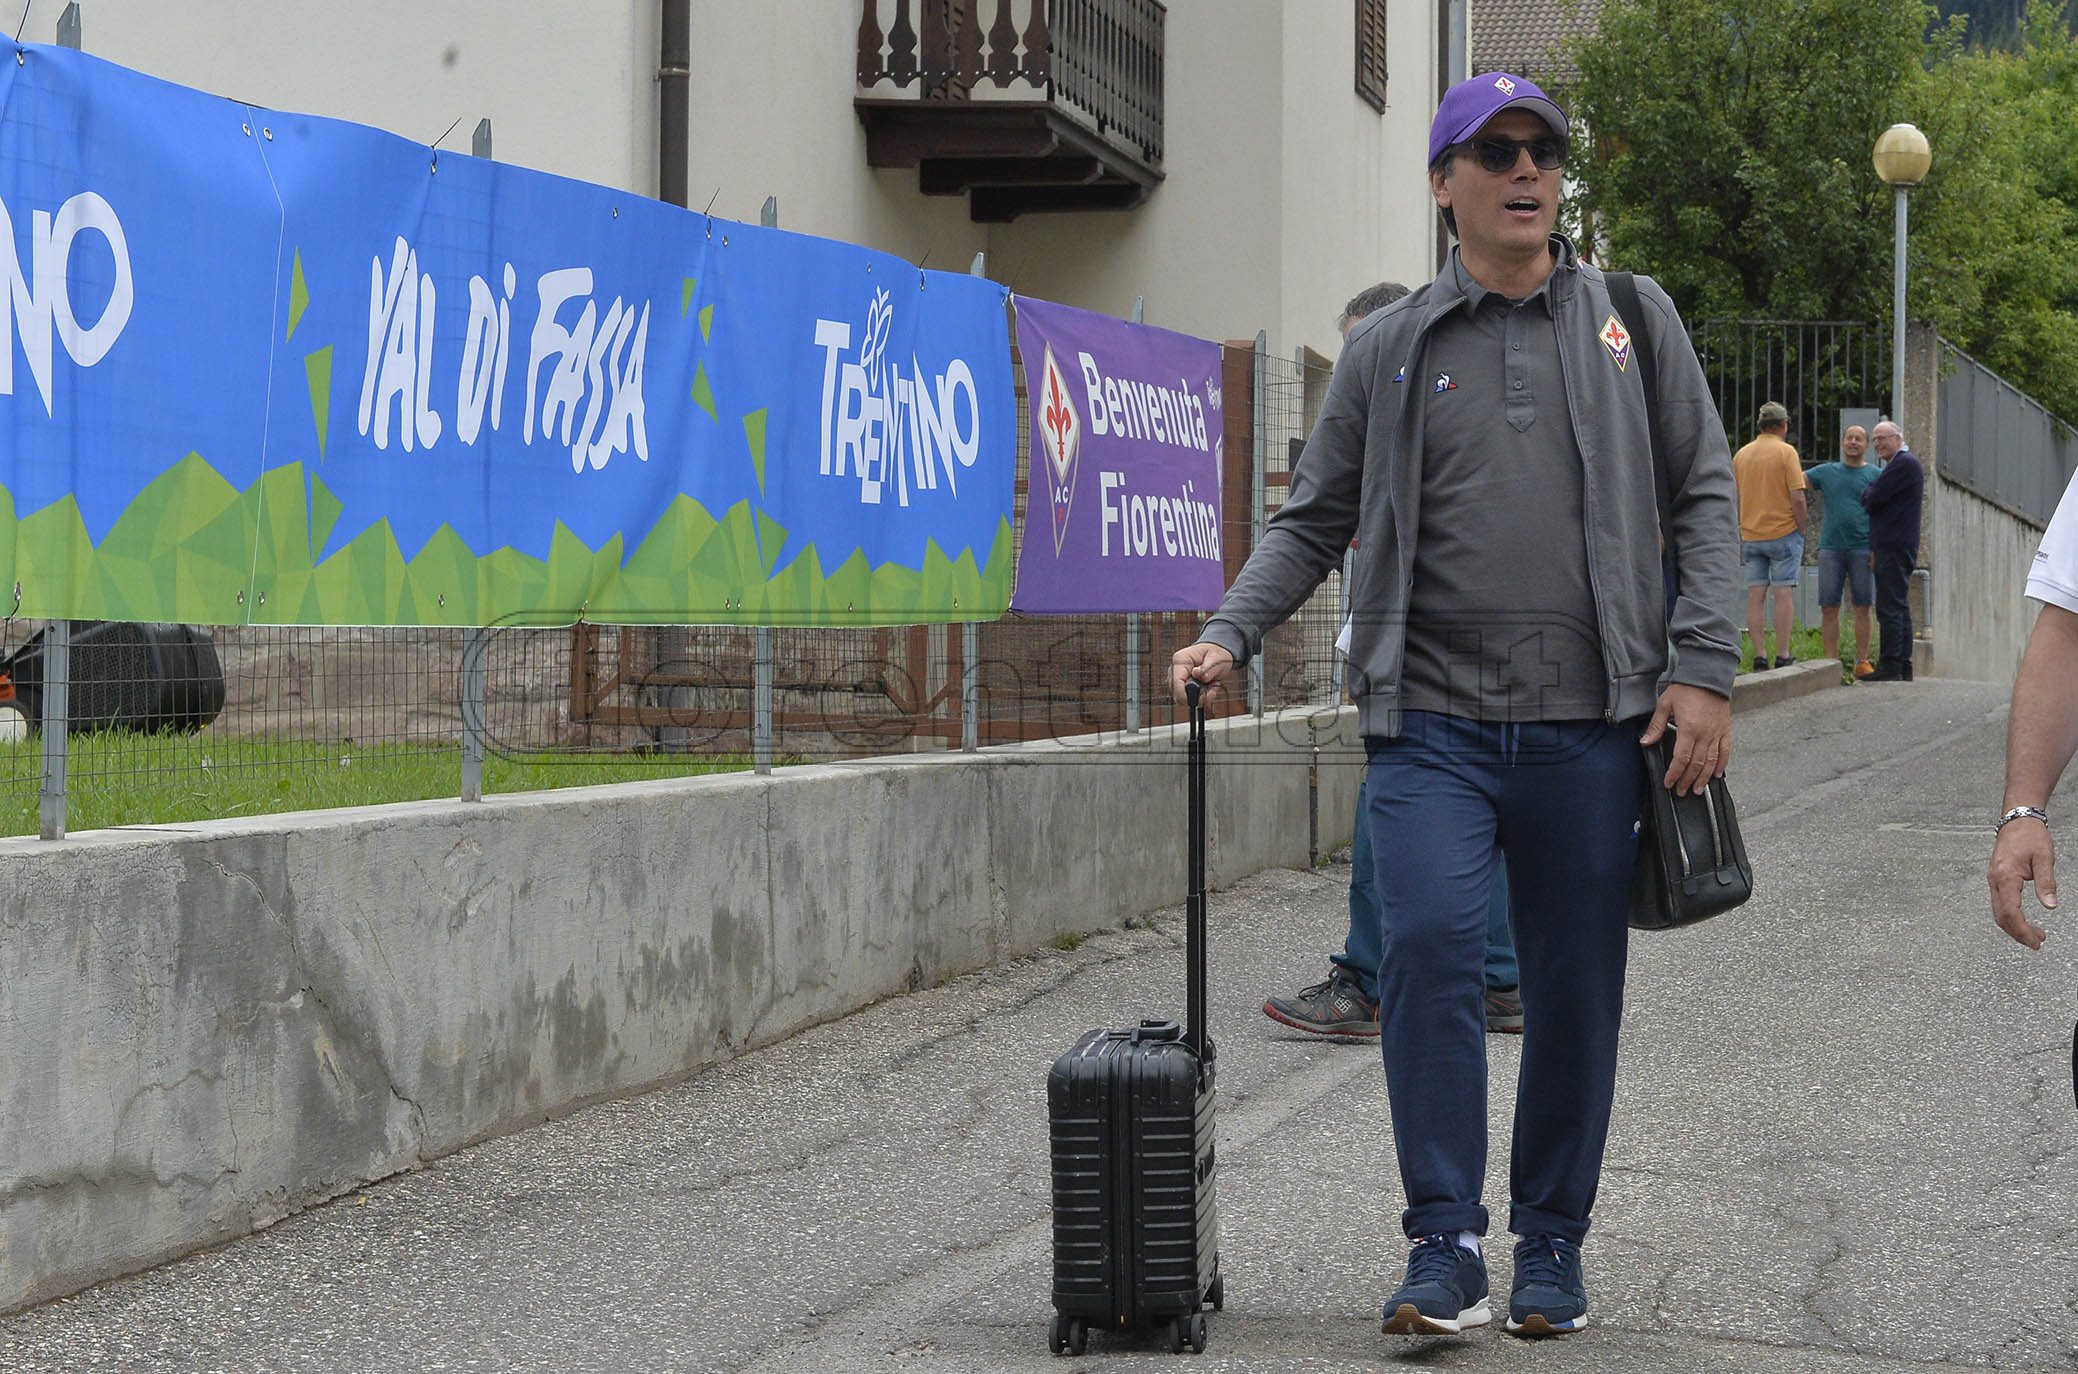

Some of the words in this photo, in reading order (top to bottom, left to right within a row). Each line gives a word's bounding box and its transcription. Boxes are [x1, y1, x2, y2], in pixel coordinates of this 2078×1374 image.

[358, 235, 441, 452] VAL
[523, 267, 649, 473] FASSA
[814, 318, 979, 506] TRENTINO
[1079, 352, 1209, 451] Benvenuta
[1101, 472, 1221, 561] Fiorentina
